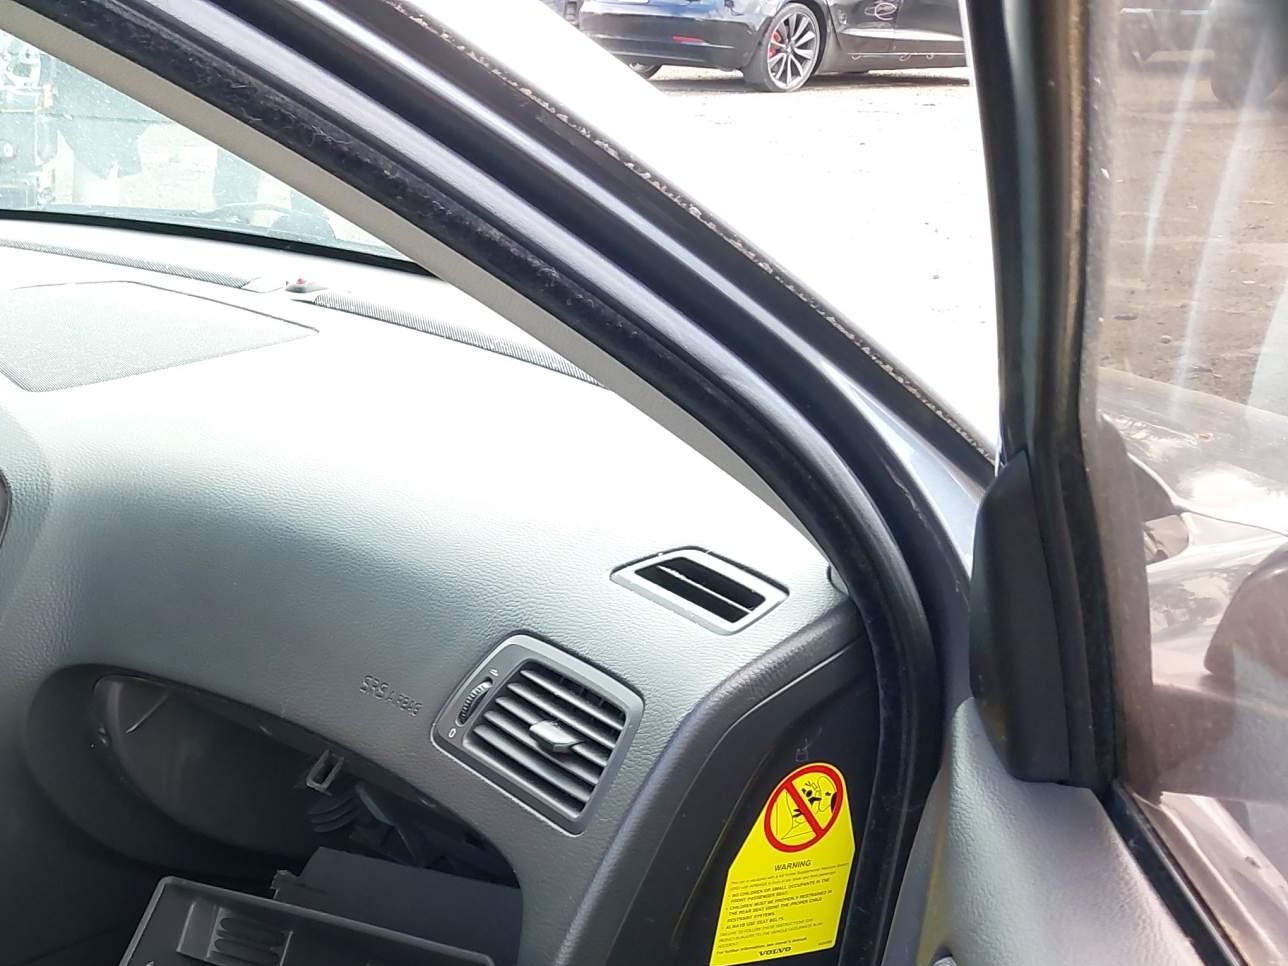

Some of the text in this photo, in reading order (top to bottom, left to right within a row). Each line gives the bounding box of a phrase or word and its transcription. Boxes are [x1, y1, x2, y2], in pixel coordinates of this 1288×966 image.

[360, 674, 389, 700] SRS
[774, 860, 811, 871] WARNING
[758, 946, 791, 957] VOLVO
